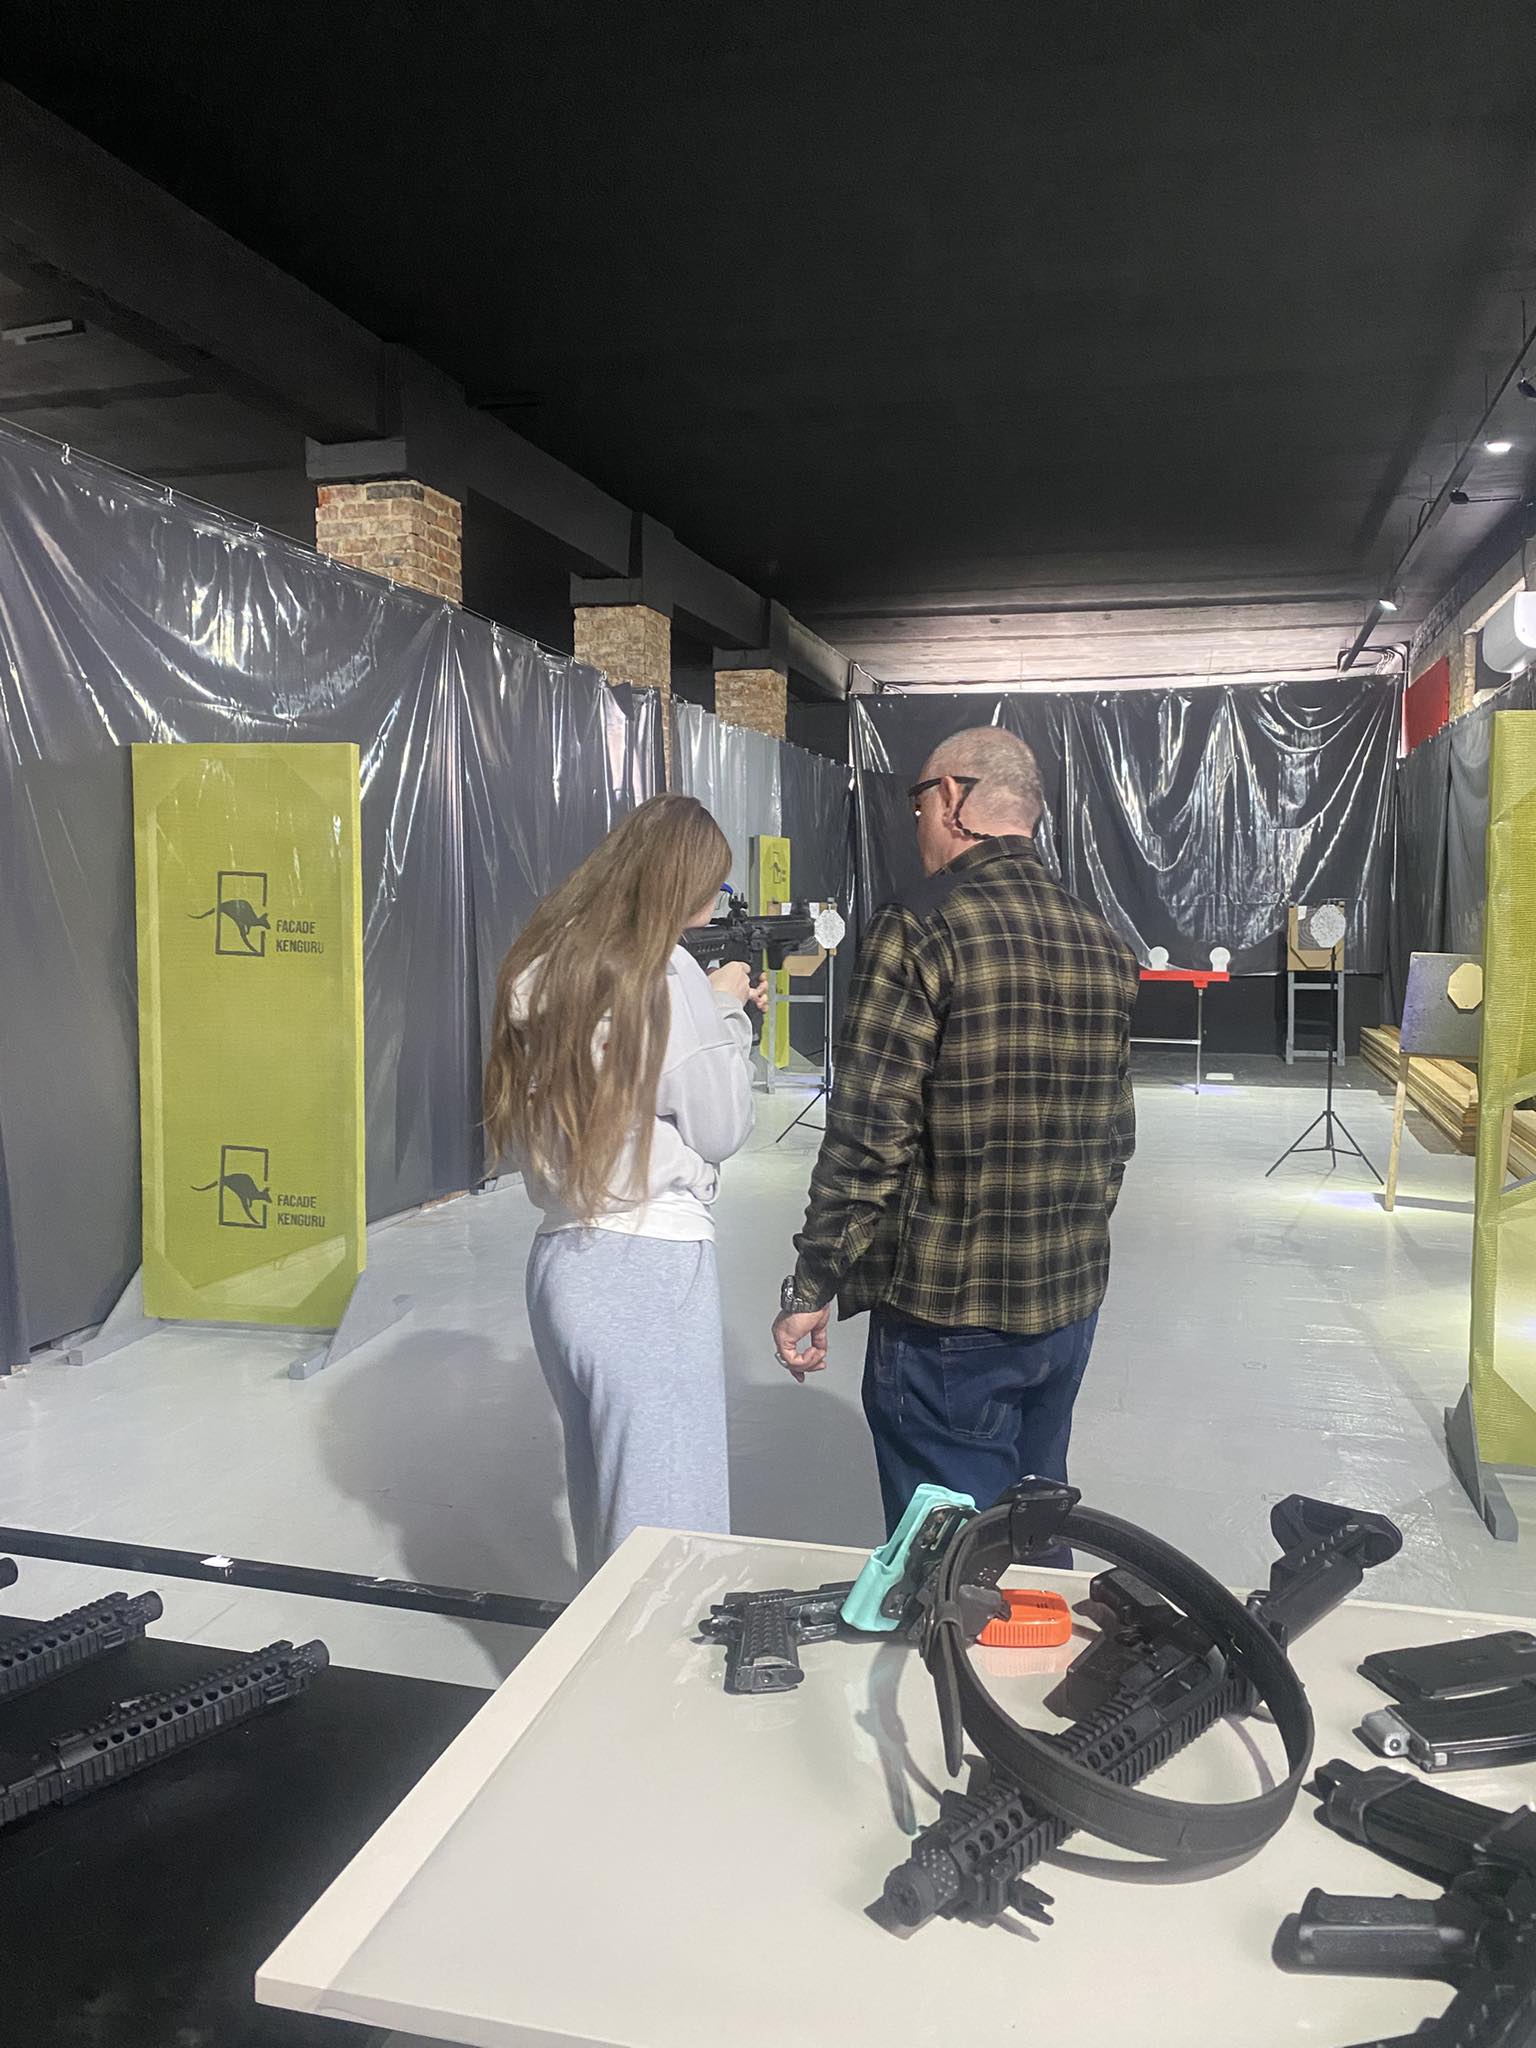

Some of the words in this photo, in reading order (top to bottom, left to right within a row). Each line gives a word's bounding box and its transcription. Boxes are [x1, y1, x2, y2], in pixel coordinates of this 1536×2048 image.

[276, 919, 316, 934] FACADE
[276, 939, 324, 954] KENGURU
[277, 1194, 317, 1209] FACADE
[277, 1213, 325, 1228] KENGURU
